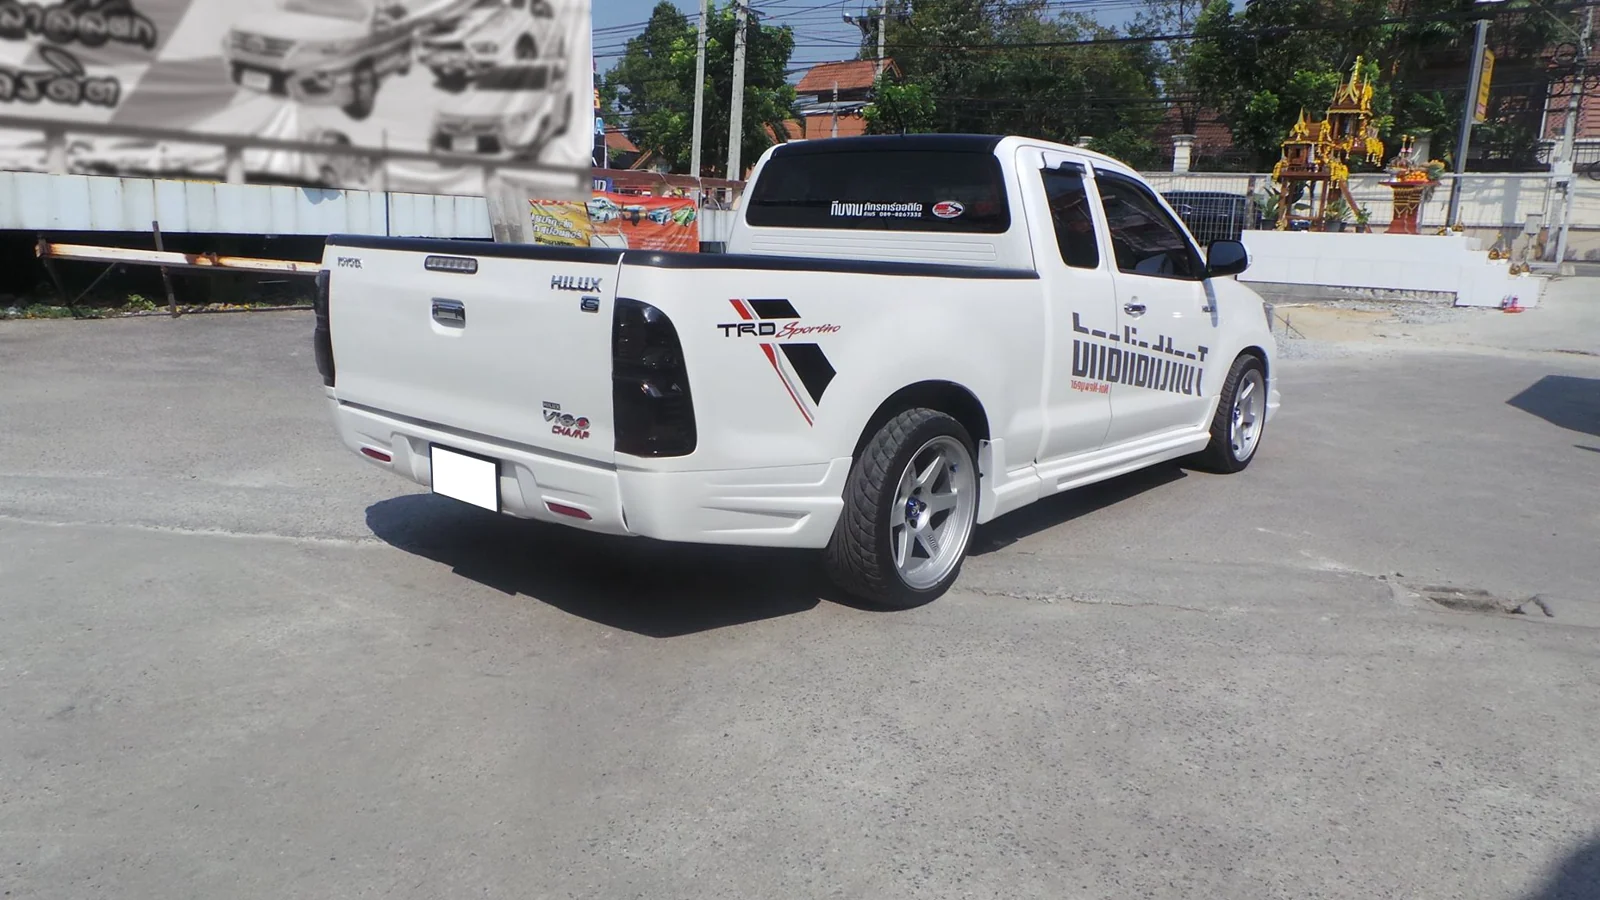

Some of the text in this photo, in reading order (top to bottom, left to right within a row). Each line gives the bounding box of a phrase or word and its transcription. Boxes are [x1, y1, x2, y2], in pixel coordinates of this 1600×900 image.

[551, 275, 603, 292] HILUX
[717, 321, 841, 339] TRD Sportivo
[543, 409, 590, 430] VIGO
[552, 425, 590, 439] CHAMP
